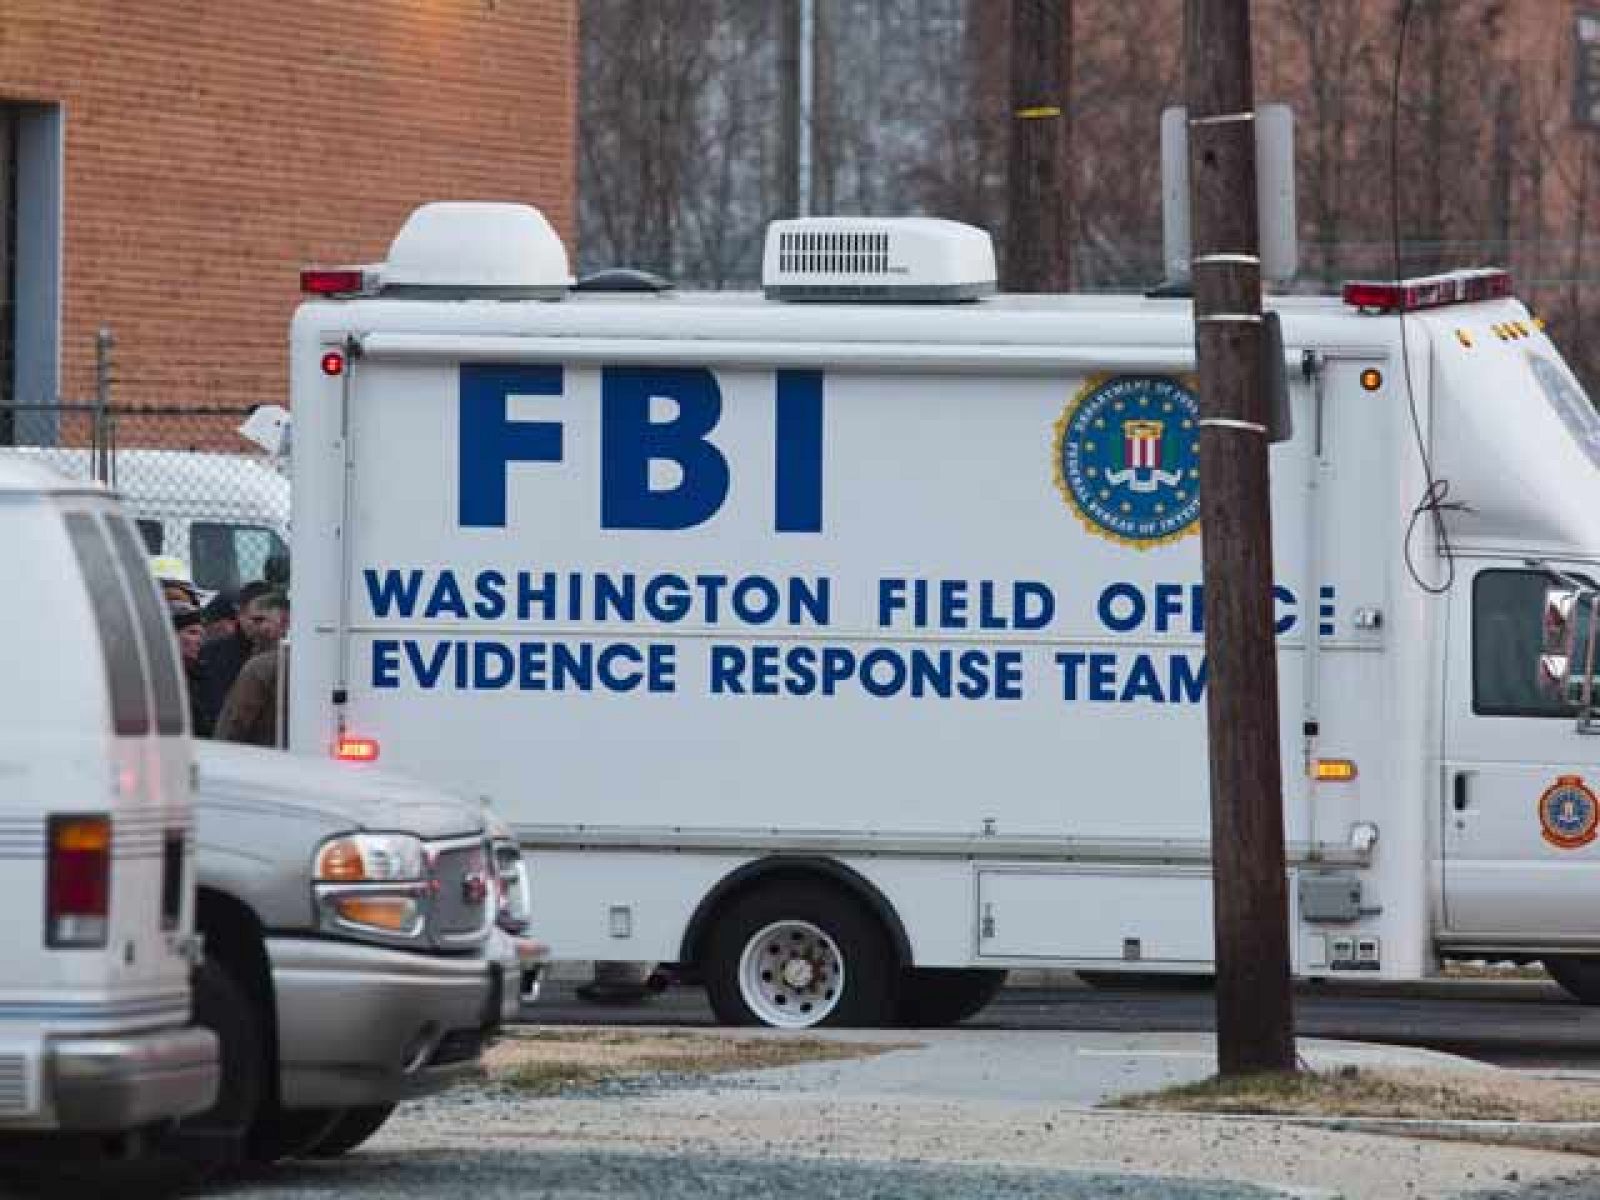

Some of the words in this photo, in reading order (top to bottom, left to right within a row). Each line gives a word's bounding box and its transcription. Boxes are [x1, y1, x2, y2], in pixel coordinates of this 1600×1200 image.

[459, 363, 824, 533] FBI
[364, 569, 829, 627] WASHINGTON
[879, 579, 1056, 631] FIELD
[372, 639, 676, 694] EVIDENCE
[711, 646, 1022, 701] RESPONSE
[1056, 652, 1208, 704] TEAM
